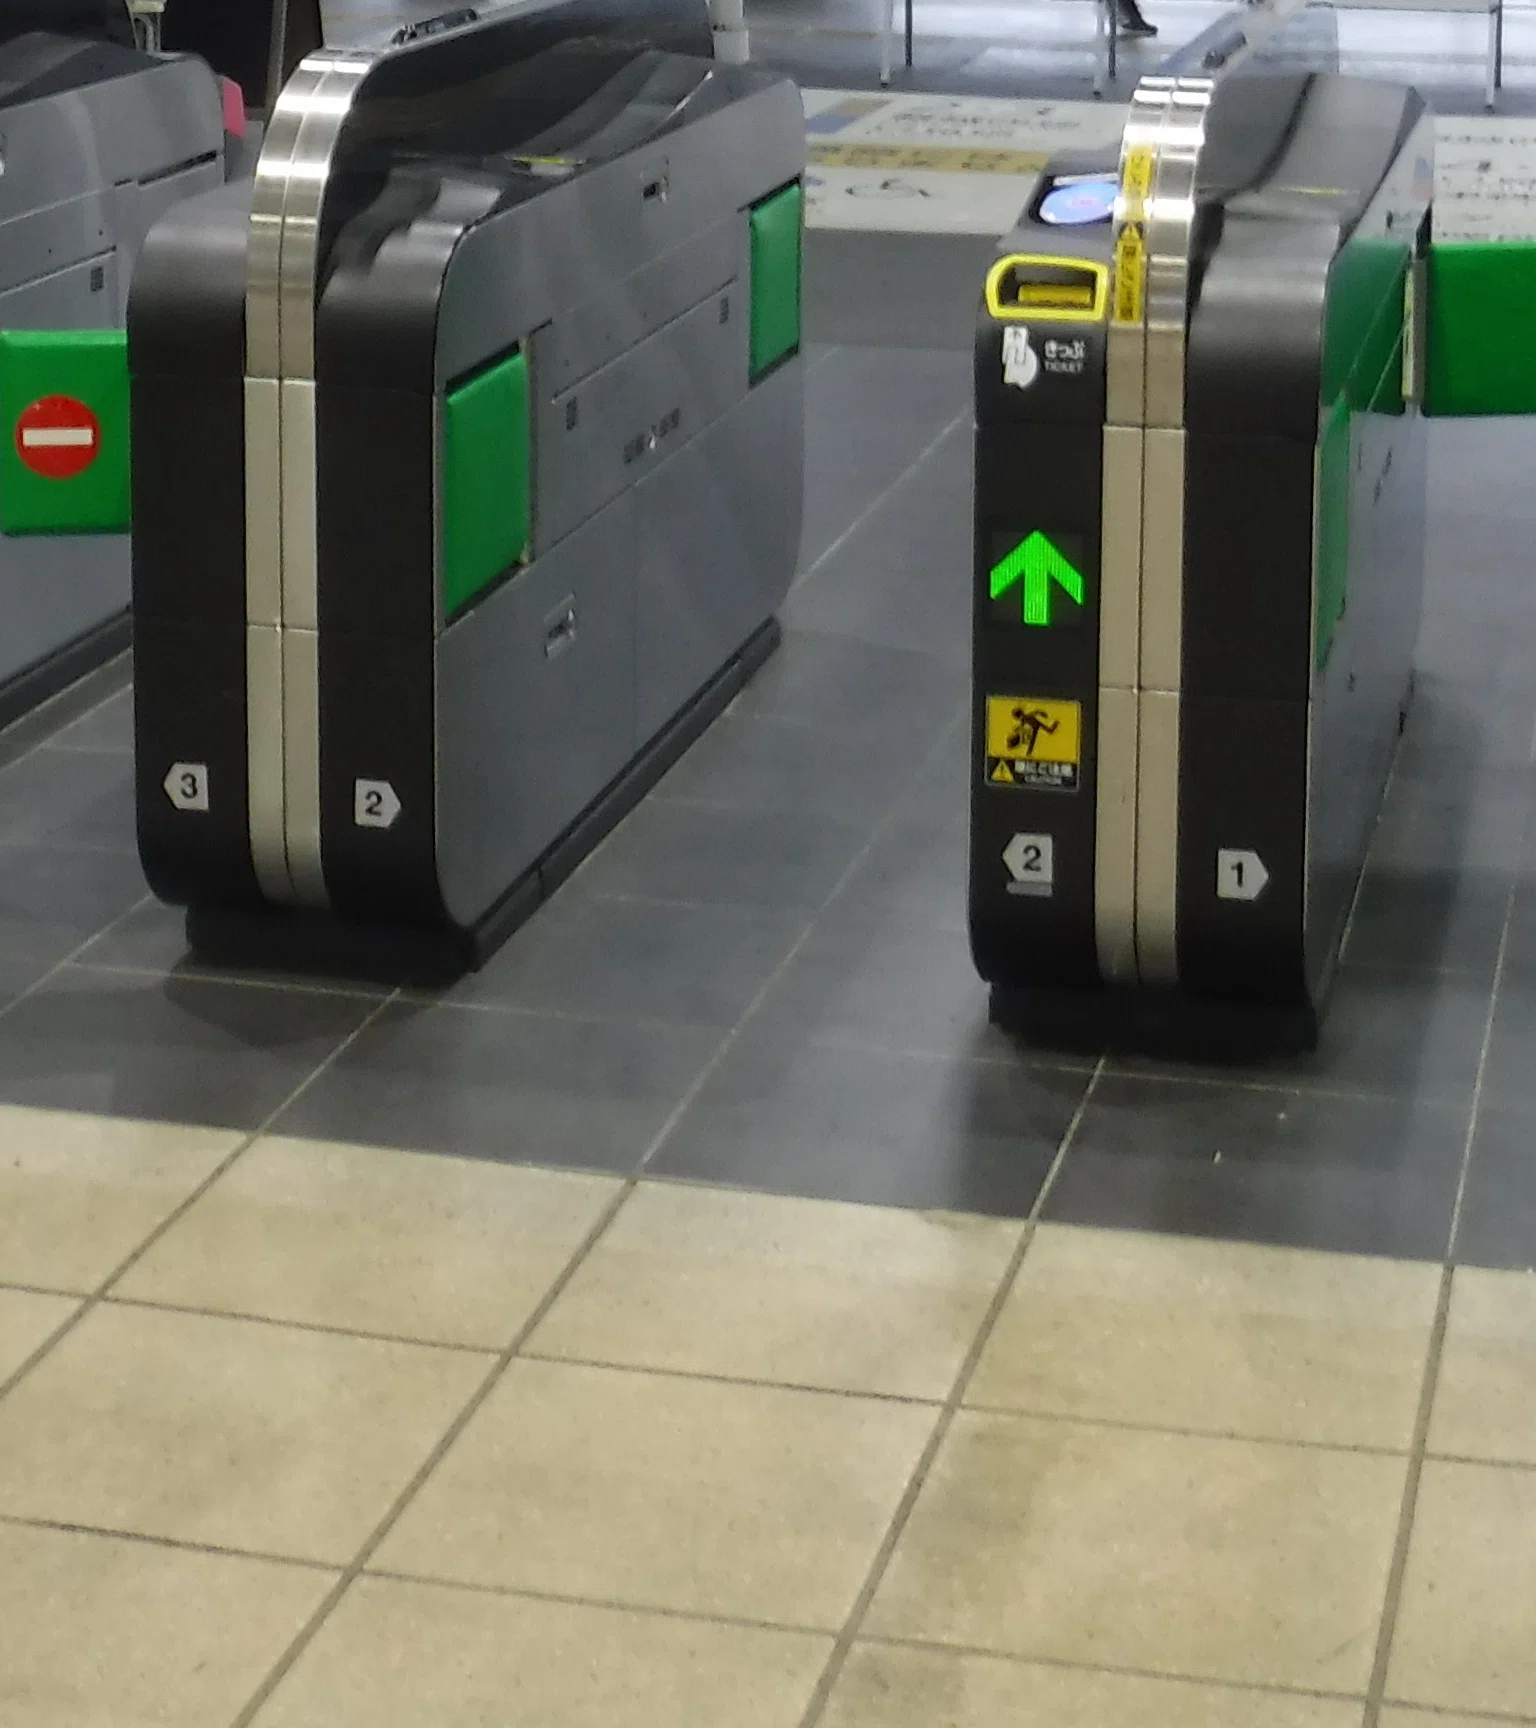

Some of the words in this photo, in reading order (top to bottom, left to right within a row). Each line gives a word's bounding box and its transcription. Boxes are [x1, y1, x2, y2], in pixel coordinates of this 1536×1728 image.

[180, 774, 198, 799] 3
[366, 792, 382, 817] 2
[1023, 845, 1042, 872] 2
[1231, 862, 1244, 888] 1
